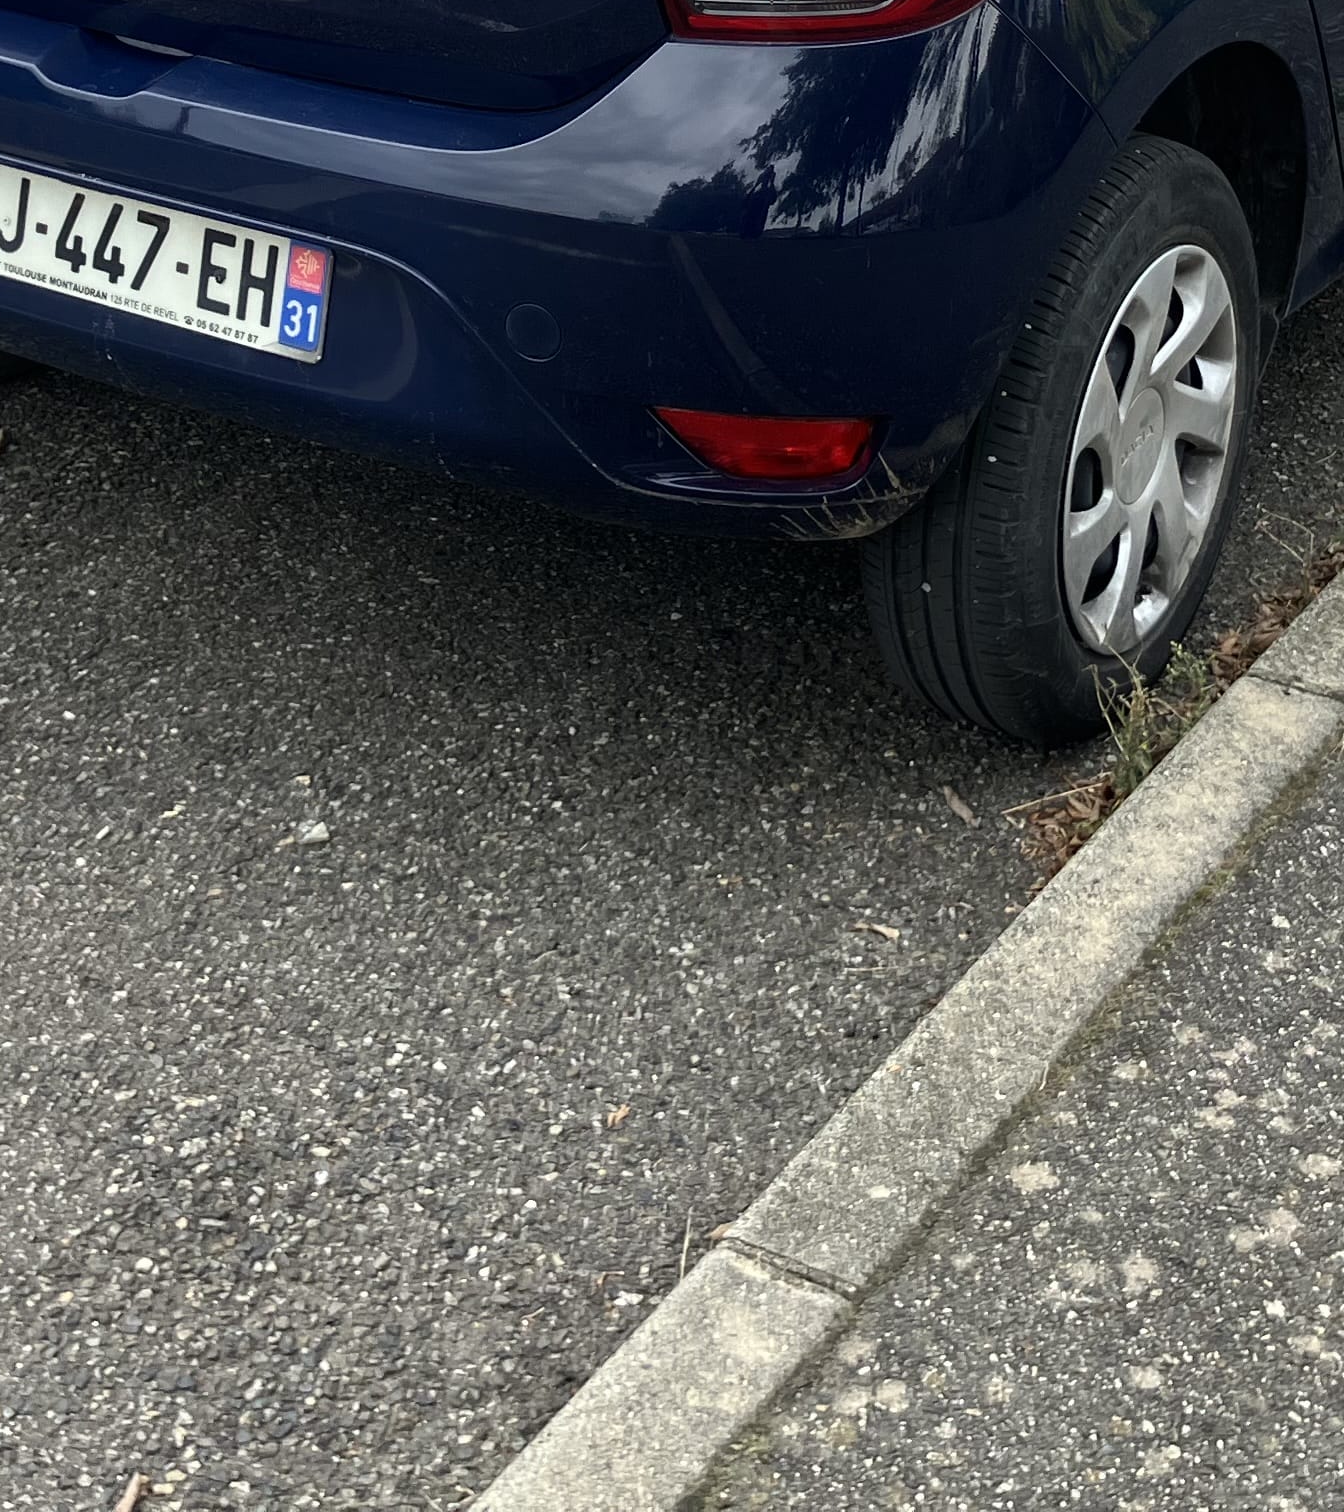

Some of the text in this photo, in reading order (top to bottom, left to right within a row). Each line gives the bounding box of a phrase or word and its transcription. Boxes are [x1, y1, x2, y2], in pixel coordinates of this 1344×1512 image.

[3, 262, 47, 283] TOULOUSE
[49, 276, 108, 301] MONTAUDRAN
[124, 297, 140, 310] RTE
[141, 302, 152, 314] DE
[154, 306, 179, 322] REVEL
[196, 318, 207, 330] 05
[283, 299, 318, 343] 31
